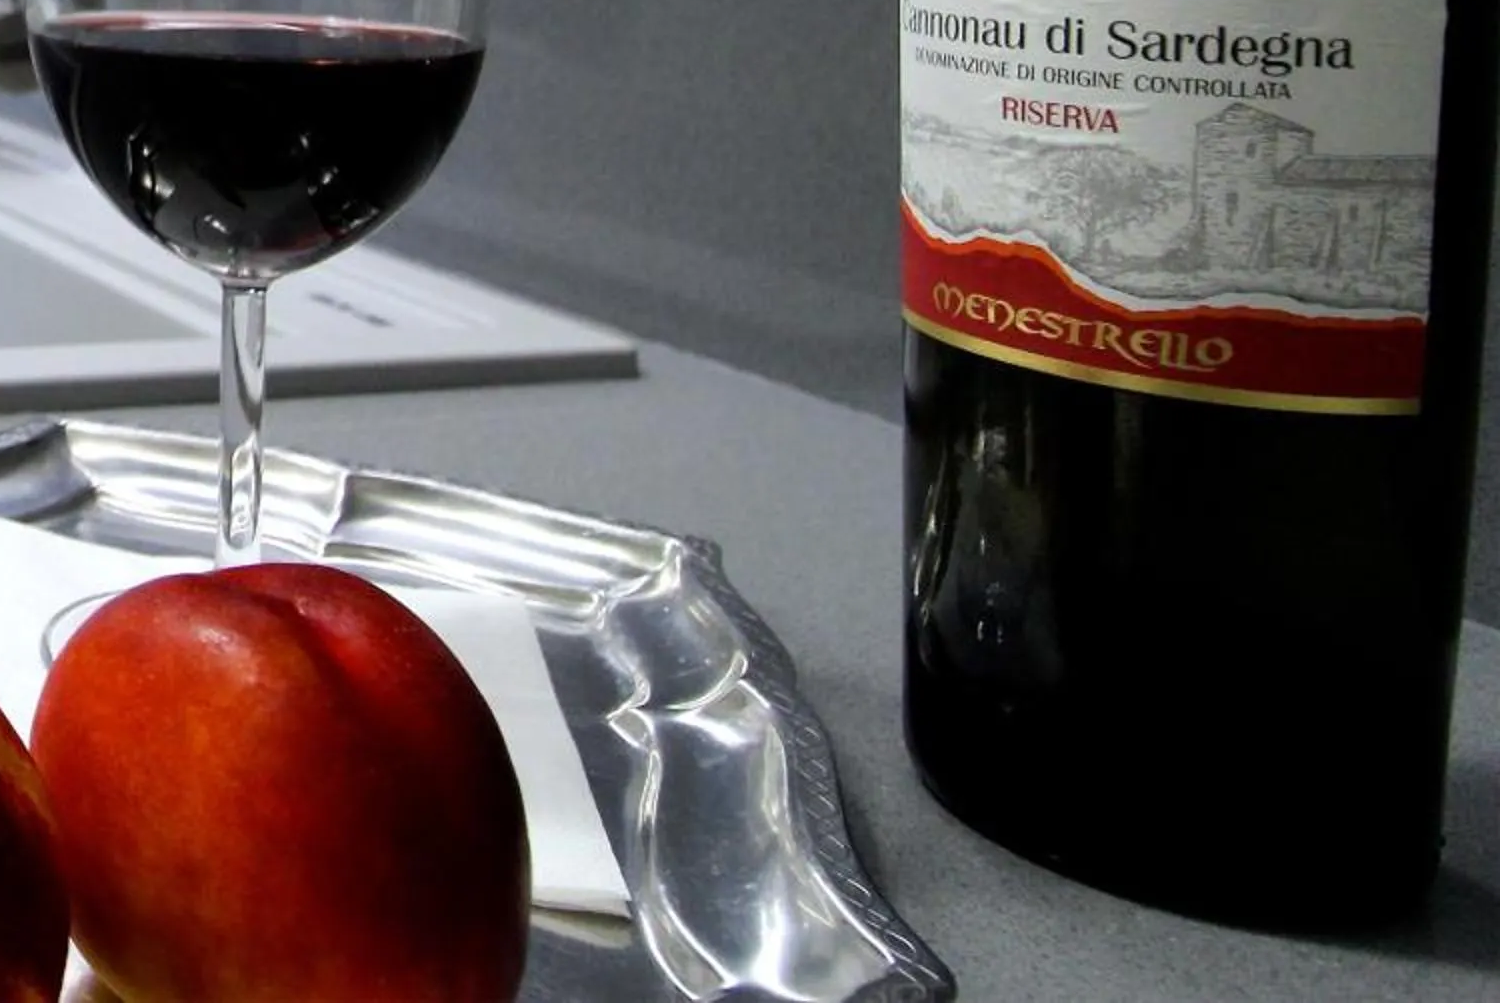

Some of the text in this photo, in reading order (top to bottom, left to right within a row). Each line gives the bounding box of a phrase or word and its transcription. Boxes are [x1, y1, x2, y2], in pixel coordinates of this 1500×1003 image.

[1045, 17, 1084, 56] di
[1107, 20, 1355, 78] Sardegna
[1017, 62, 1035, 81] DI
[1043, 66, 1125, 90] ORIGINE
[1134, 73, 1292, 99] CONTROLLATA
[1002, 97, 1119, 133] RISERVA
